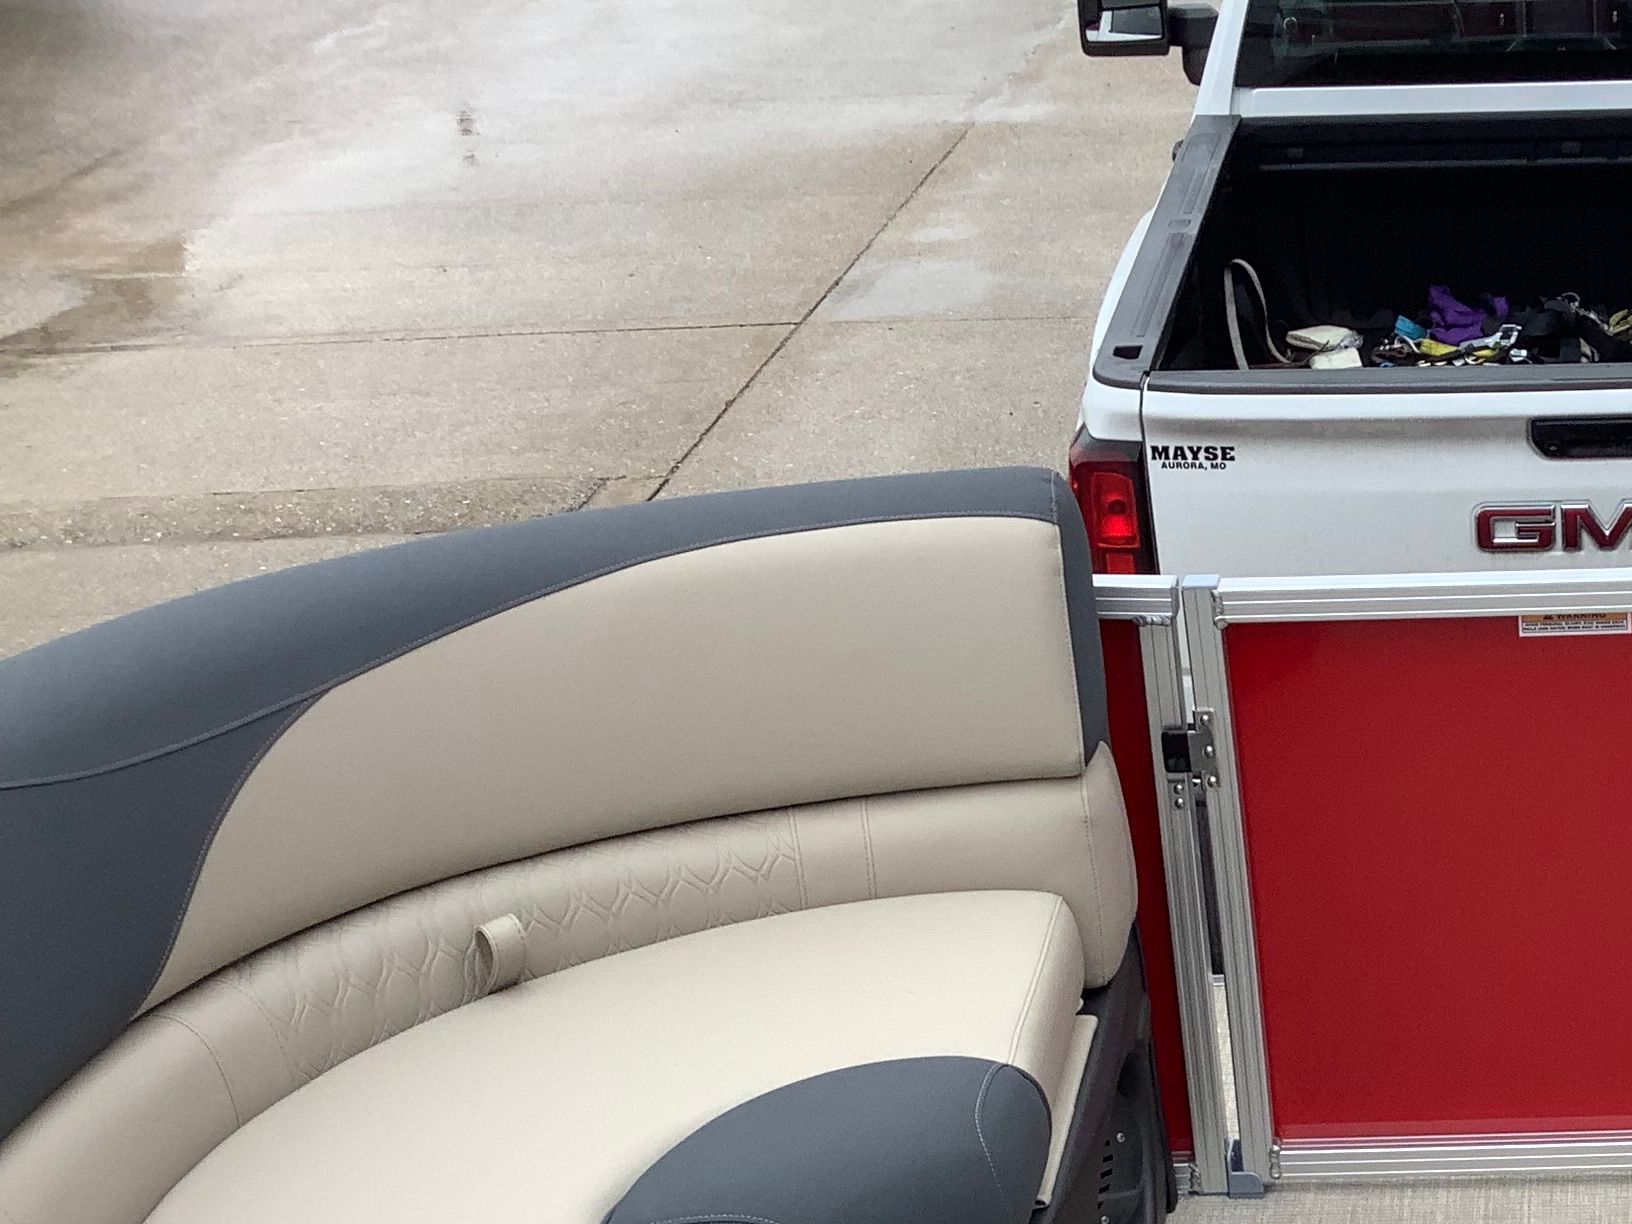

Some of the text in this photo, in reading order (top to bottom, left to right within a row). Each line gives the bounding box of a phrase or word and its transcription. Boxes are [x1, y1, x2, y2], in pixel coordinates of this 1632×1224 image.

[1150, 445, 1236, 461] MAYSE
[1161, 461, 1227, 471] AURORA, MO
